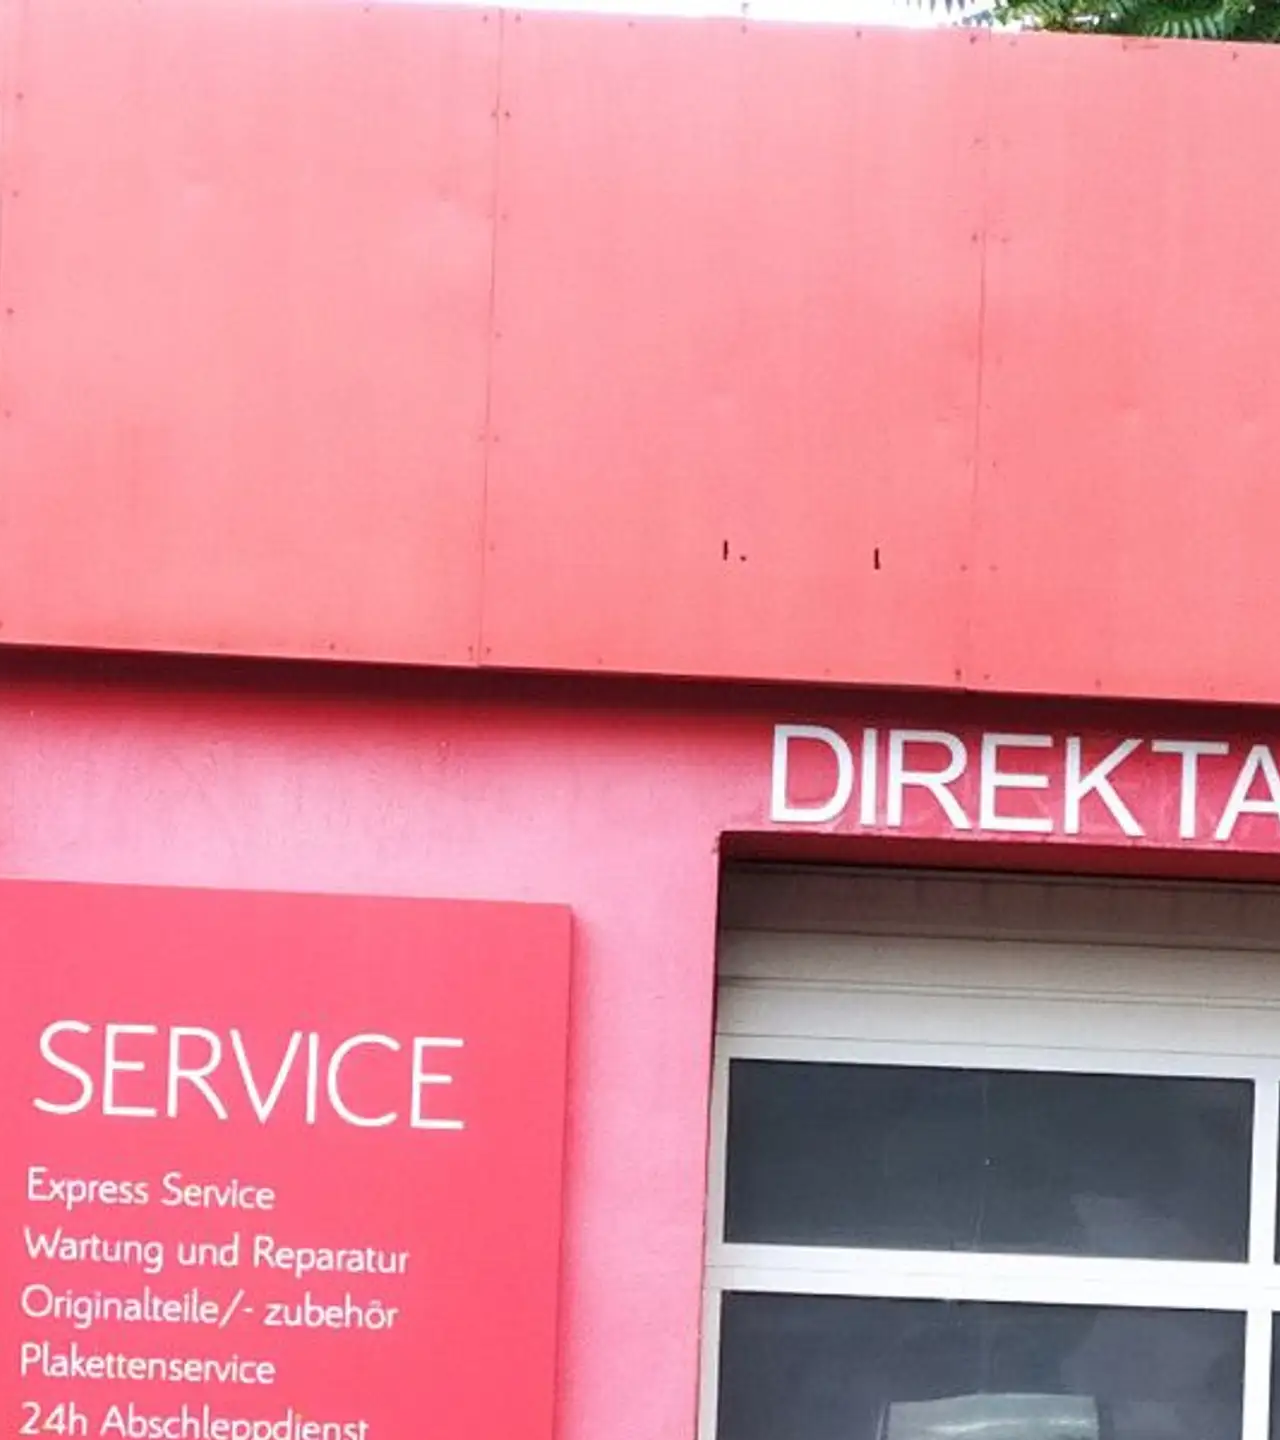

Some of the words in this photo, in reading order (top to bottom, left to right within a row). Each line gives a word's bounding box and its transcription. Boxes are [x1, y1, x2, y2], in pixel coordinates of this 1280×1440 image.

[33, 1019, 464, 1130] SERVICE
[28, 1166, 149, 1211] Express
[161, 1171, 275, 1210] Service
[24, 1227, 164, 1274] Wartung
[177, 1232, 240, 1267] und
[253, 1235, 408, 1278] Reparatur
[263, 1291, 398, 1329] zubehör
[21, 1341, 276, 1384] Plakettenservice
[20, 1401, 88, 1436] 24h
